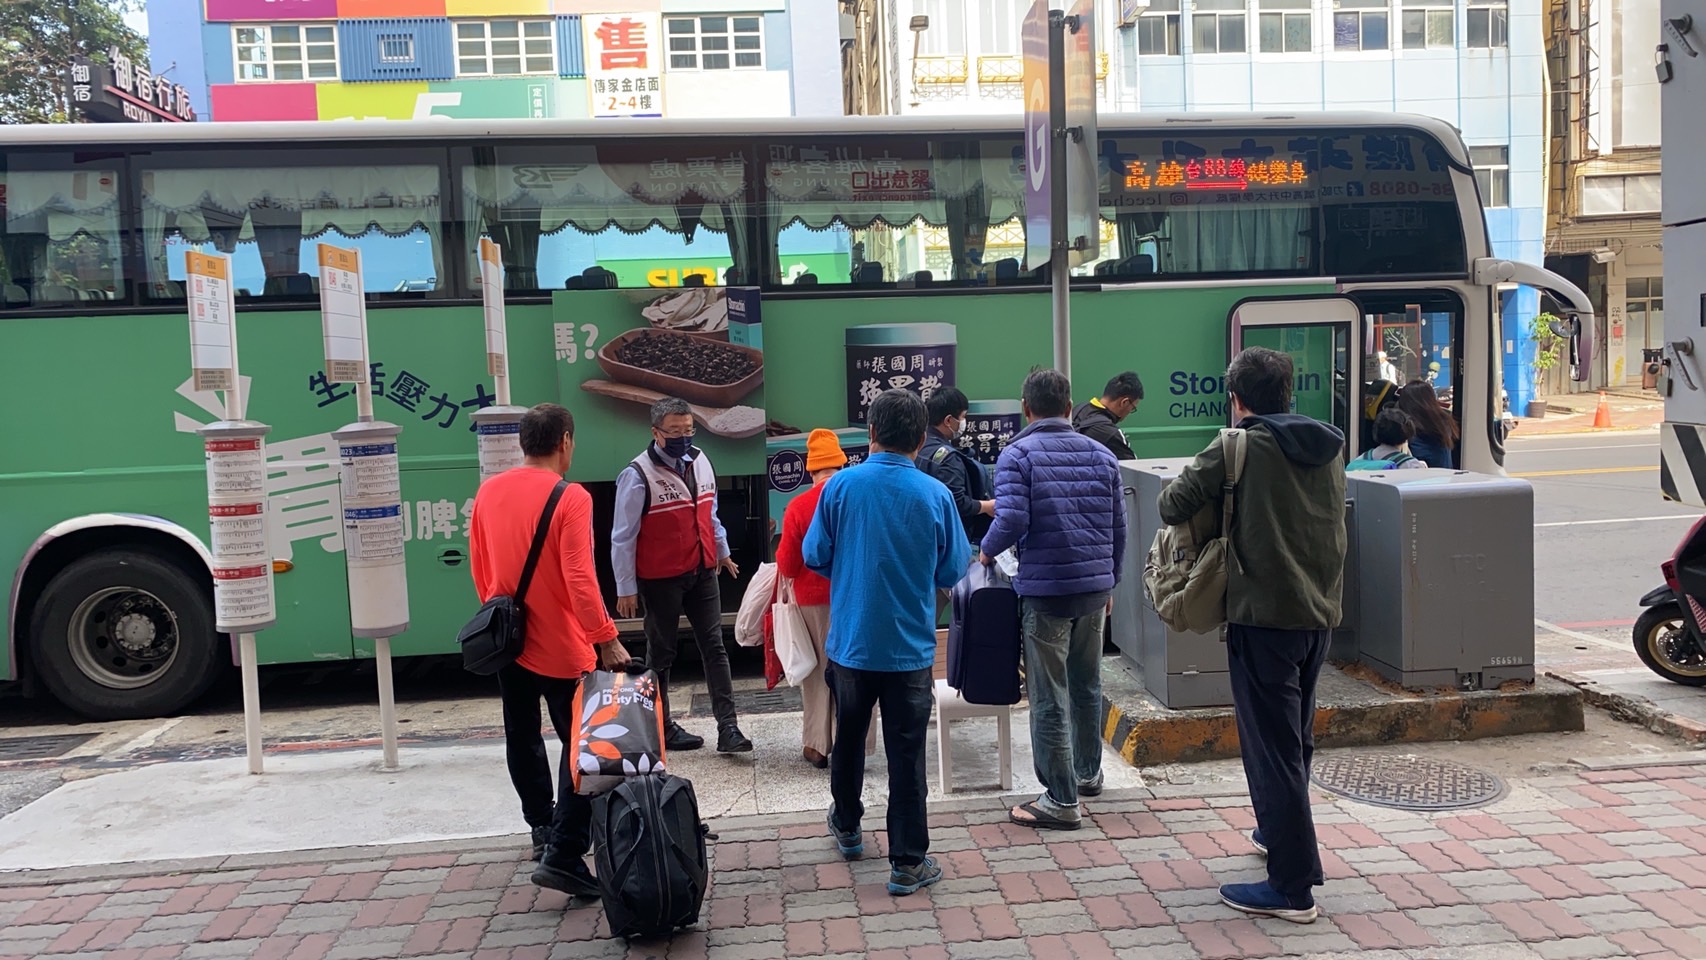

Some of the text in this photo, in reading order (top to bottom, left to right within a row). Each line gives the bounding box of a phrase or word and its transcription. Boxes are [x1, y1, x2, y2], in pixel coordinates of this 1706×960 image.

[594, 18, 648, 70] 售
[71, 62, 91, 102] 御宿
[109, 45, 192, 120] 御宿行旅
[1029, 78, 1046, 192] G
